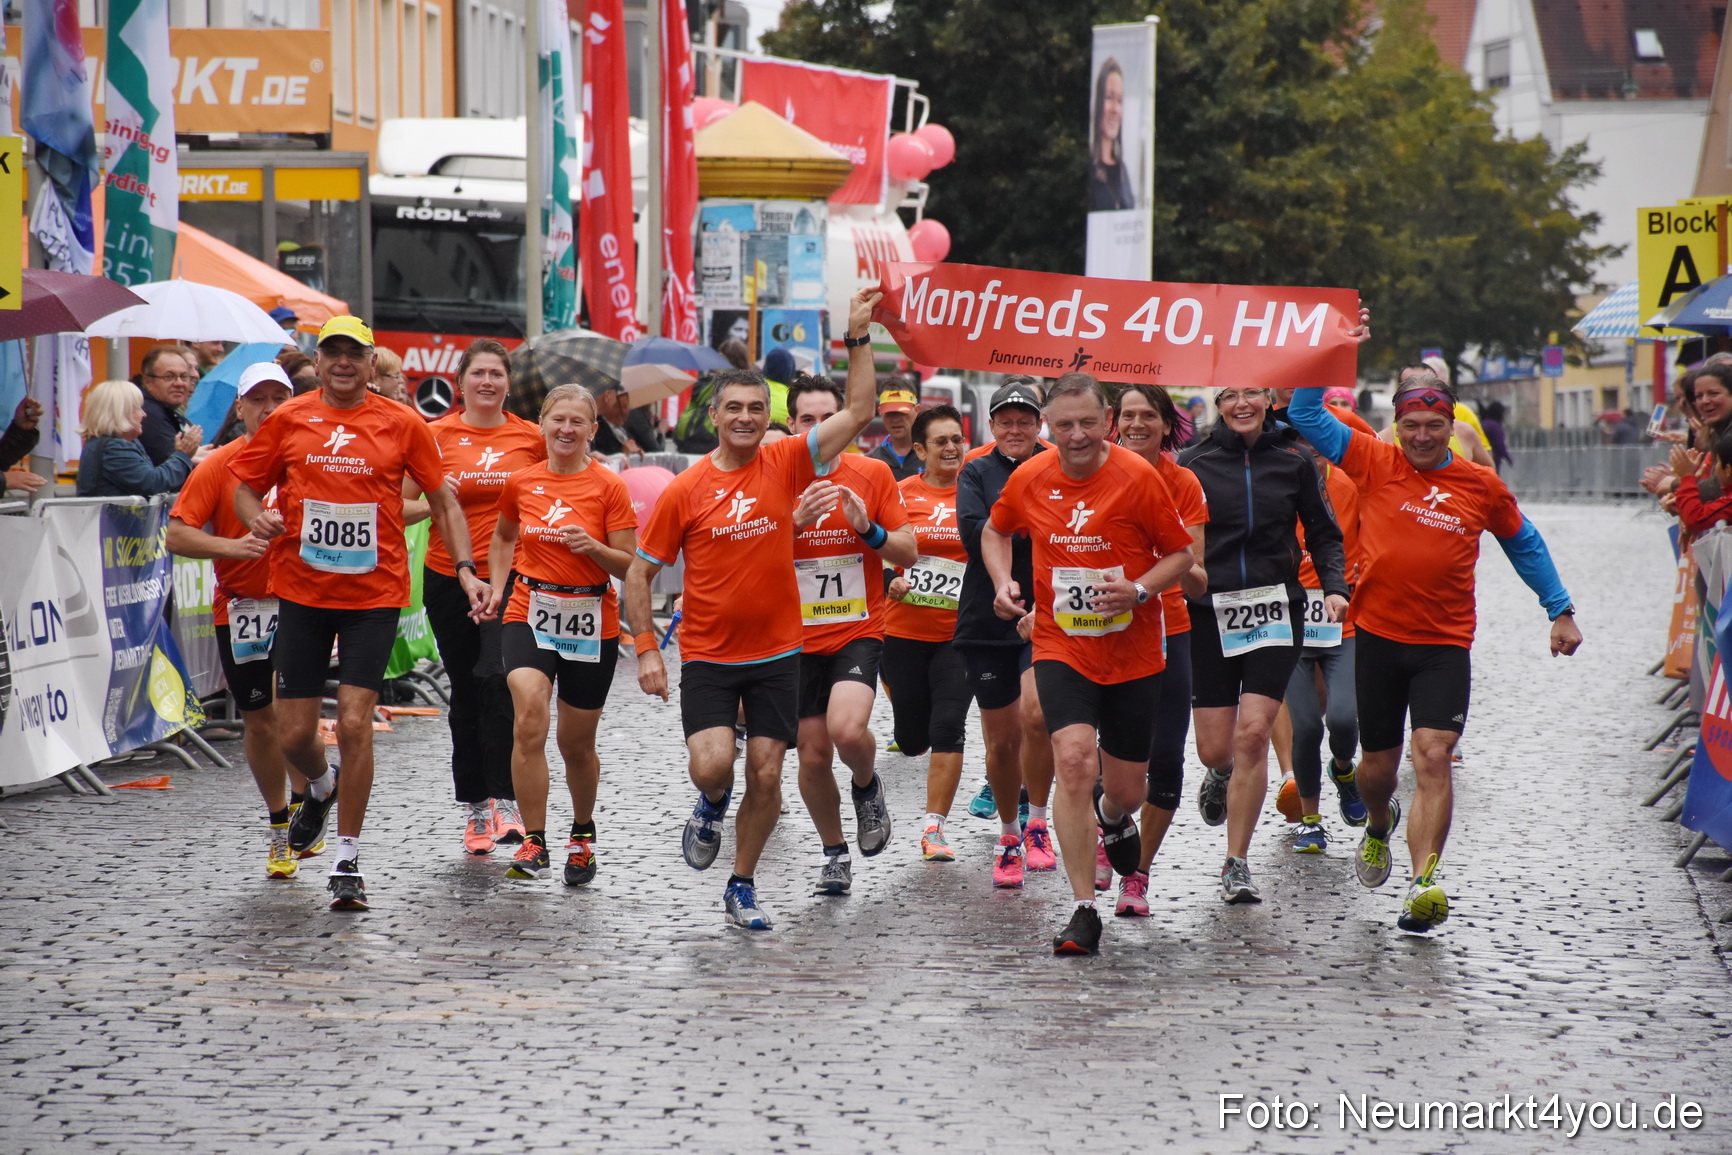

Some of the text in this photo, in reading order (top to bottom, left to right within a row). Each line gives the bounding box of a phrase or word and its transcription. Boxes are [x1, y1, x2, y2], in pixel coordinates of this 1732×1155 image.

[1648, 210, 1717, 235] Block
[1657, 245, 1702, 308] A
[901, 276, 1329, 347] Manfreds 40. HM
[988, 348, 1163, 376] funrunners neumarkt
[305, 453, 365, 466] funrunners
[323, 464, 374, 475] neumarkt
[458, 471, 512, 481] funrunner
[1400, 501, 1461, 525] funrunners
[308, 518, 371, 548] 3085
[712, 516, 769, 539] funrunners
[731, 521, 778, 542] neumarkt
[1416, 515, 1467, 536] neumarkt
[808, 535, 857, 547] neumarkt
[1066, 541, 1112, 553] neumarkt
[315, 550, 343, 562] Ernst
[815, 573, 843, 599] 71
[909, 567, 961, 598] 5322
[813, 603, 851, 616] Michael
[911, 595, 945, 606] KAROLA
[535, 609, 595, 636] 2143
[1224, 601, 1283, 630] 2298
[1246, 631, 1268, 643] Erika
[47, 683, 68, 723] to
